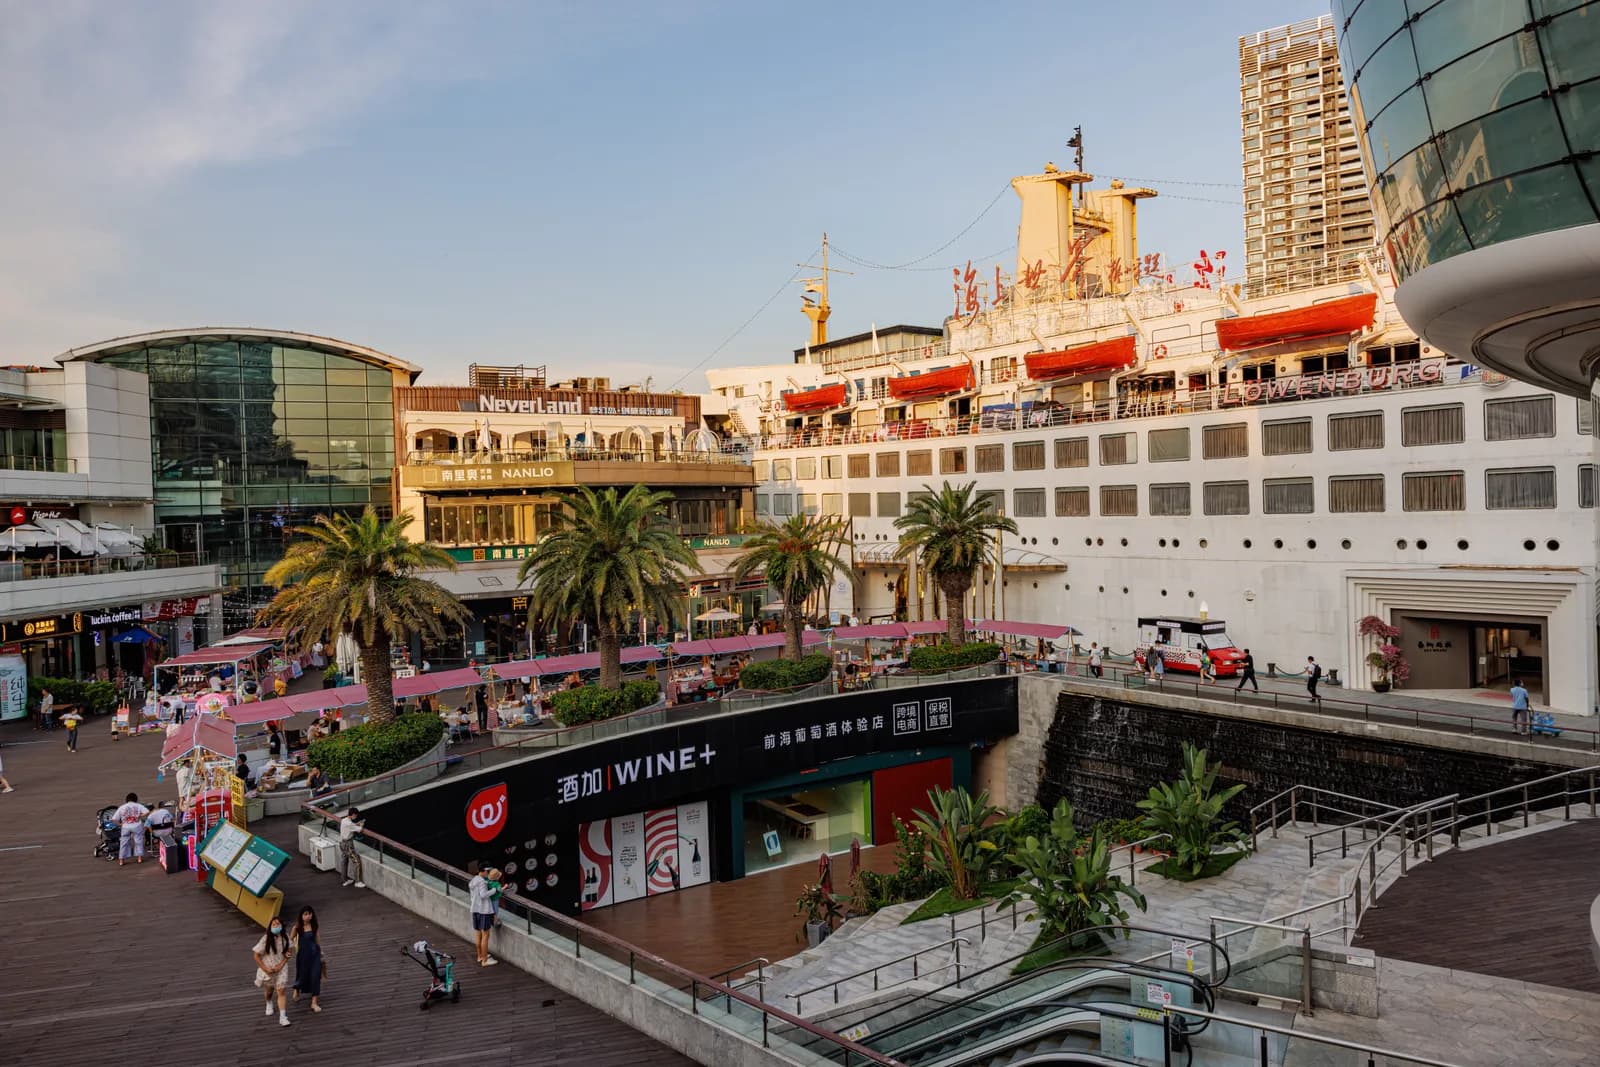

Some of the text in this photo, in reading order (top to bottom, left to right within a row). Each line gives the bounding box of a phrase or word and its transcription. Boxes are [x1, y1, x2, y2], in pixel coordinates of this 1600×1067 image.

[480, 395, 582, 414] NeverLand
[502, 467, 554, 478] NANLIO
[91, 614, 111, 625] luckin
[112, 611, 132, 622] coffee
[928, 701, 949, 715] 保税
[896, 718, 917, 731] 电商
[928, 713, 949, 727] 直营
[764, 715, 884, 750] 前海葡萄酒体验店
[614, 744, 716, 786] WINE+
